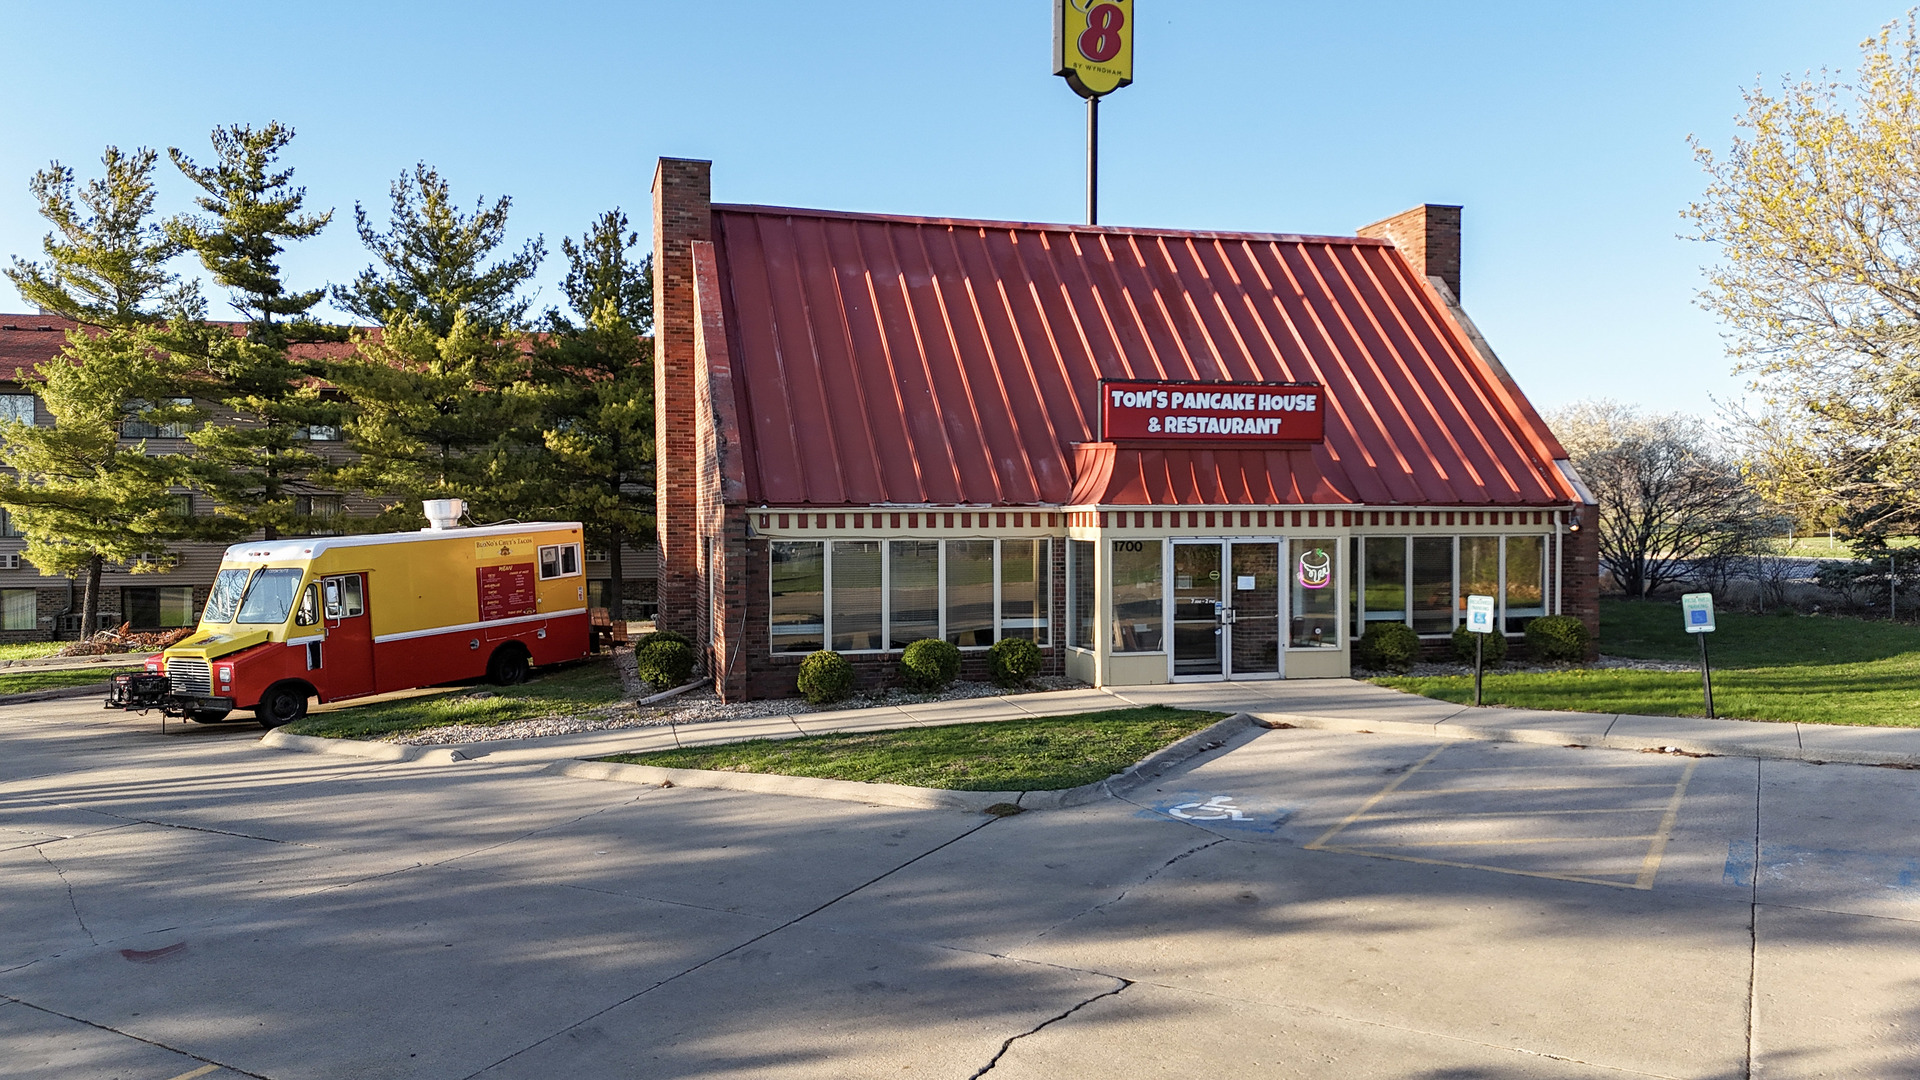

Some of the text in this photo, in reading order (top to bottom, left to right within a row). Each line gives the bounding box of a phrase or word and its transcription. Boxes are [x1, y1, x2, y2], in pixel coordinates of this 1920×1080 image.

[1077, 3, 1124, 63] 8
[1085, 65, 1122, 76] WYNDHAM
[1111, 389, 1317, 412] TOM'S PANCAKE HOUSE
[1147, 416, 1282, 435] & RESTAURANT
[1114, 540, 1143, 552] 1700
